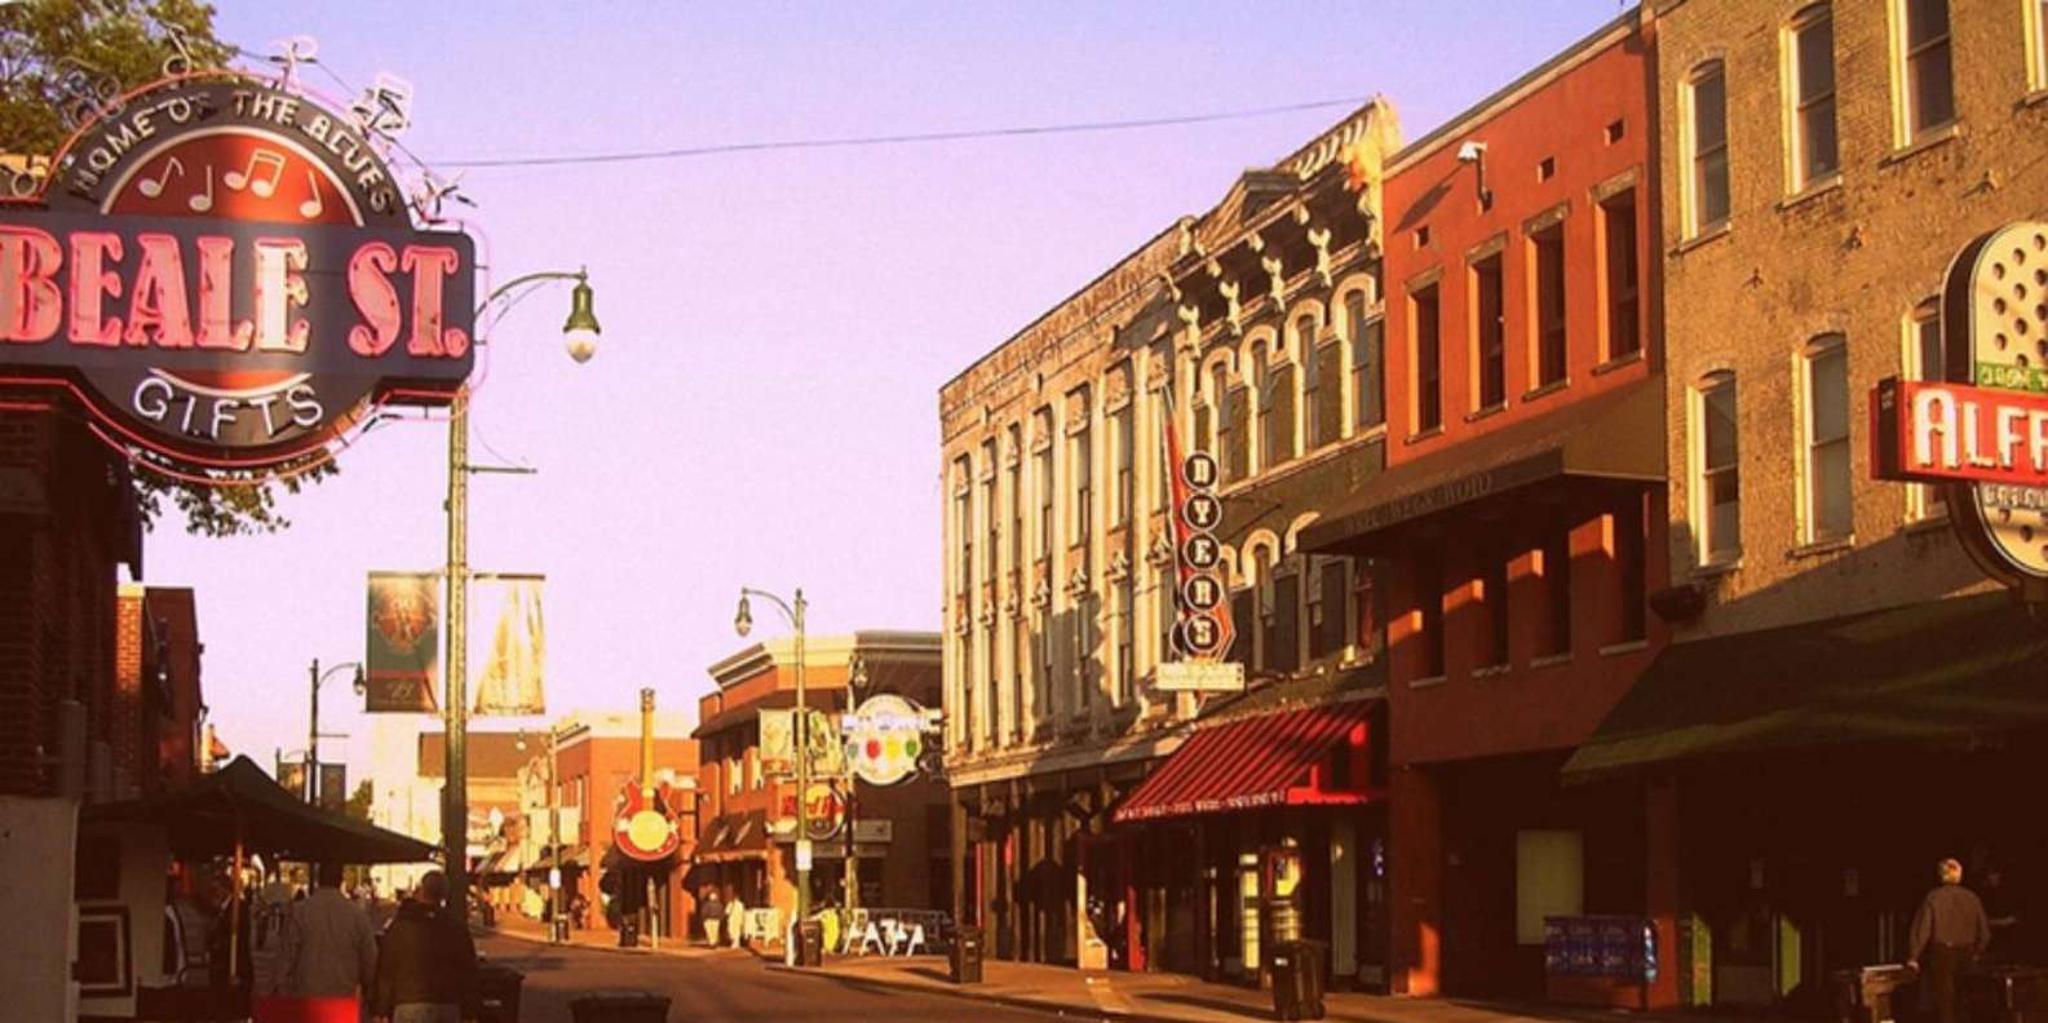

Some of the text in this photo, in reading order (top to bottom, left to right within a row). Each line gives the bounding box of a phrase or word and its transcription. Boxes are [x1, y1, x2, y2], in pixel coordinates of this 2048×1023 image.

[70, 109, 156, 199] HOME
[233, 91, 300, 126] THE
[304, 114, 396, 213] BLUES
[0, 224, 470, 358] BEALE ST.
[134, 377, 324, 438] GIFTS
